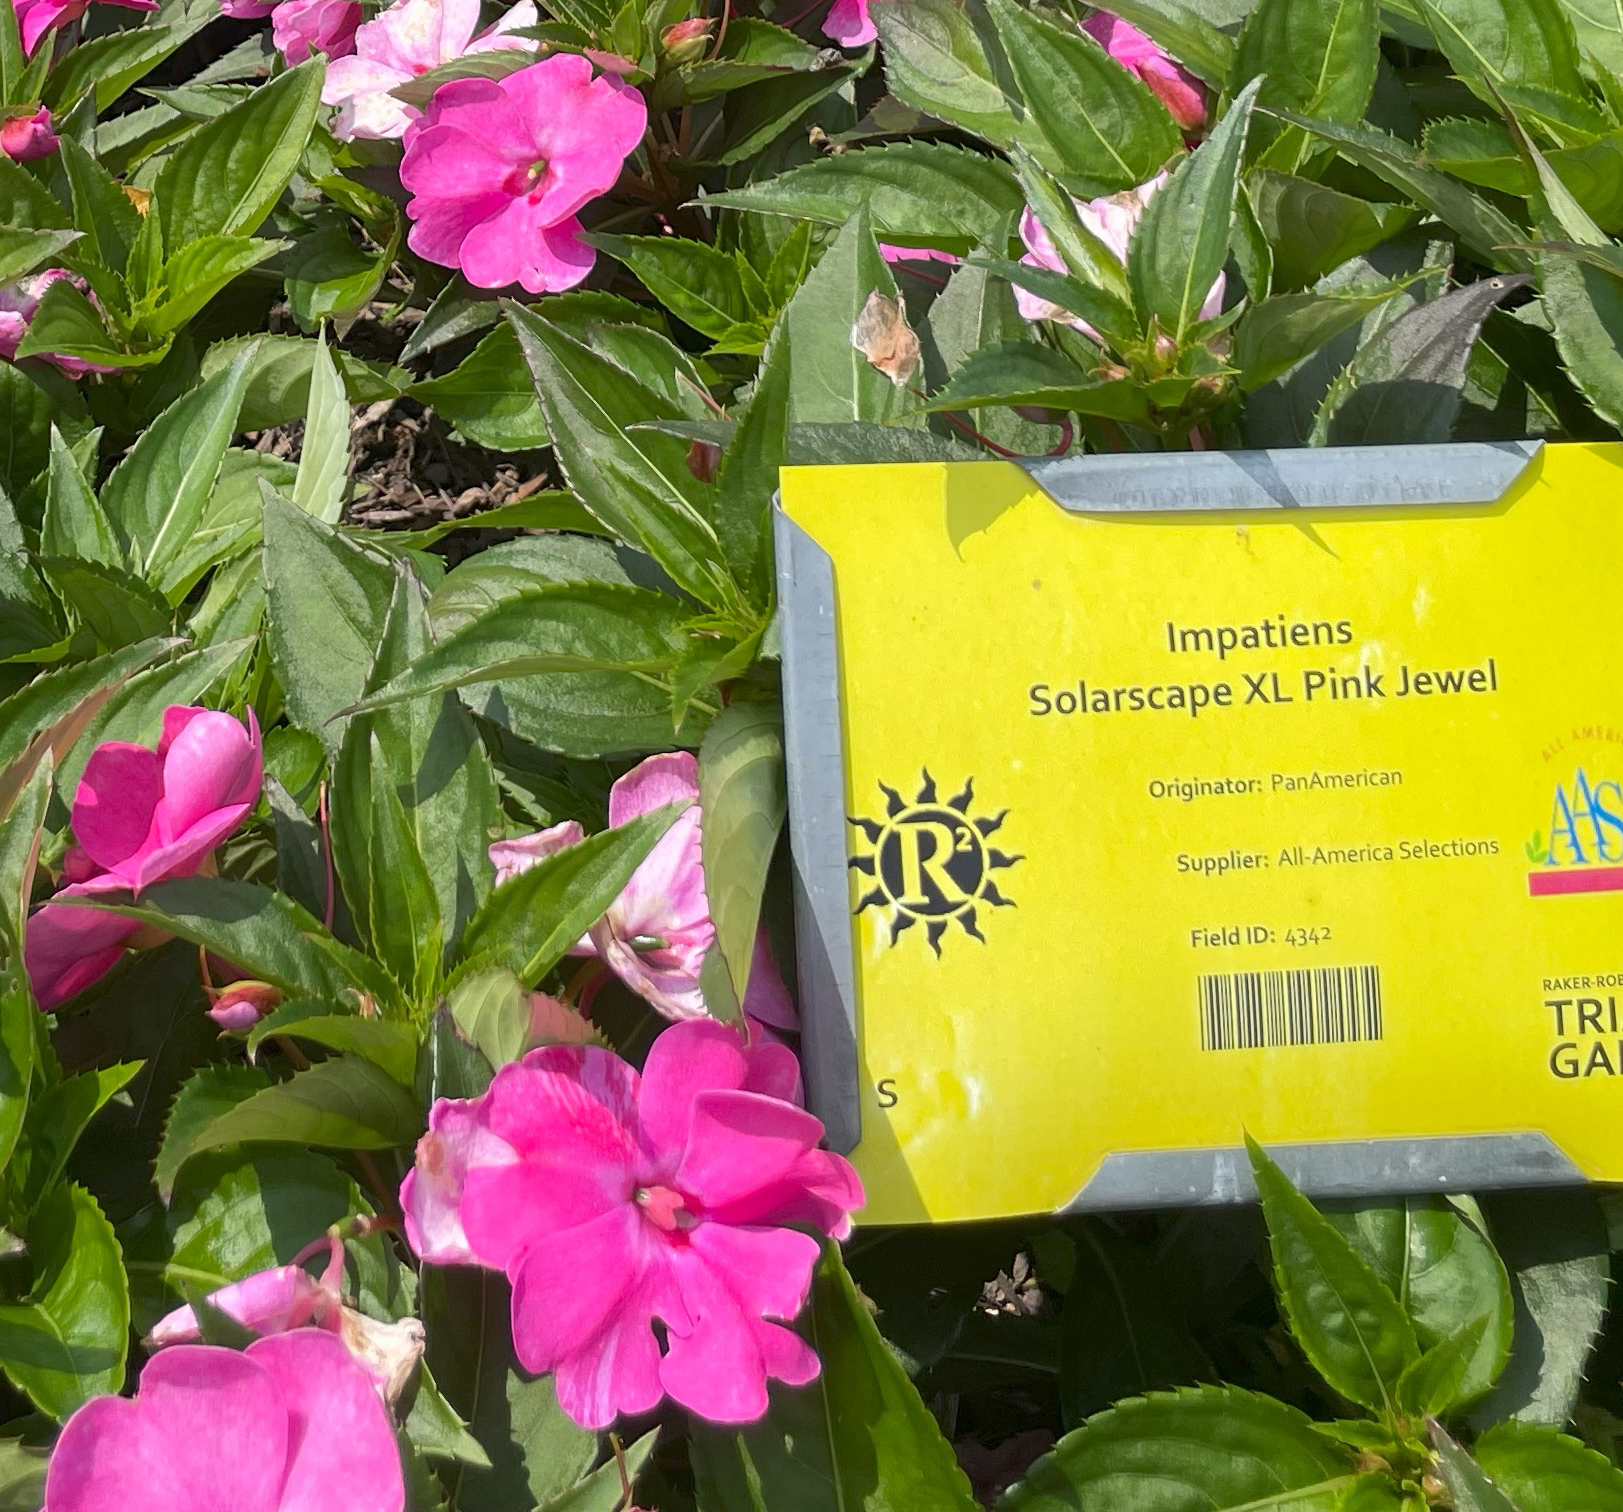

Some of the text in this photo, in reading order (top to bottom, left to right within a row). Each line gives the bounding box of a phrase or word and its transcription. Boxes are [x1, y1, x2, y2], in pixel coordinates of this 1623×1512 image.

[1166, 614, 1353, 660] Impatiens
[1030, 658, 1498, 717] Solarscape XL Pink Jewel
[1148, 769, 1404, 802] Originator: PanAmerican
[1177, 838, 1500, 876] Supplier: All-America Selections
[1191, 926, 1333, 948] Field ID: 4342
